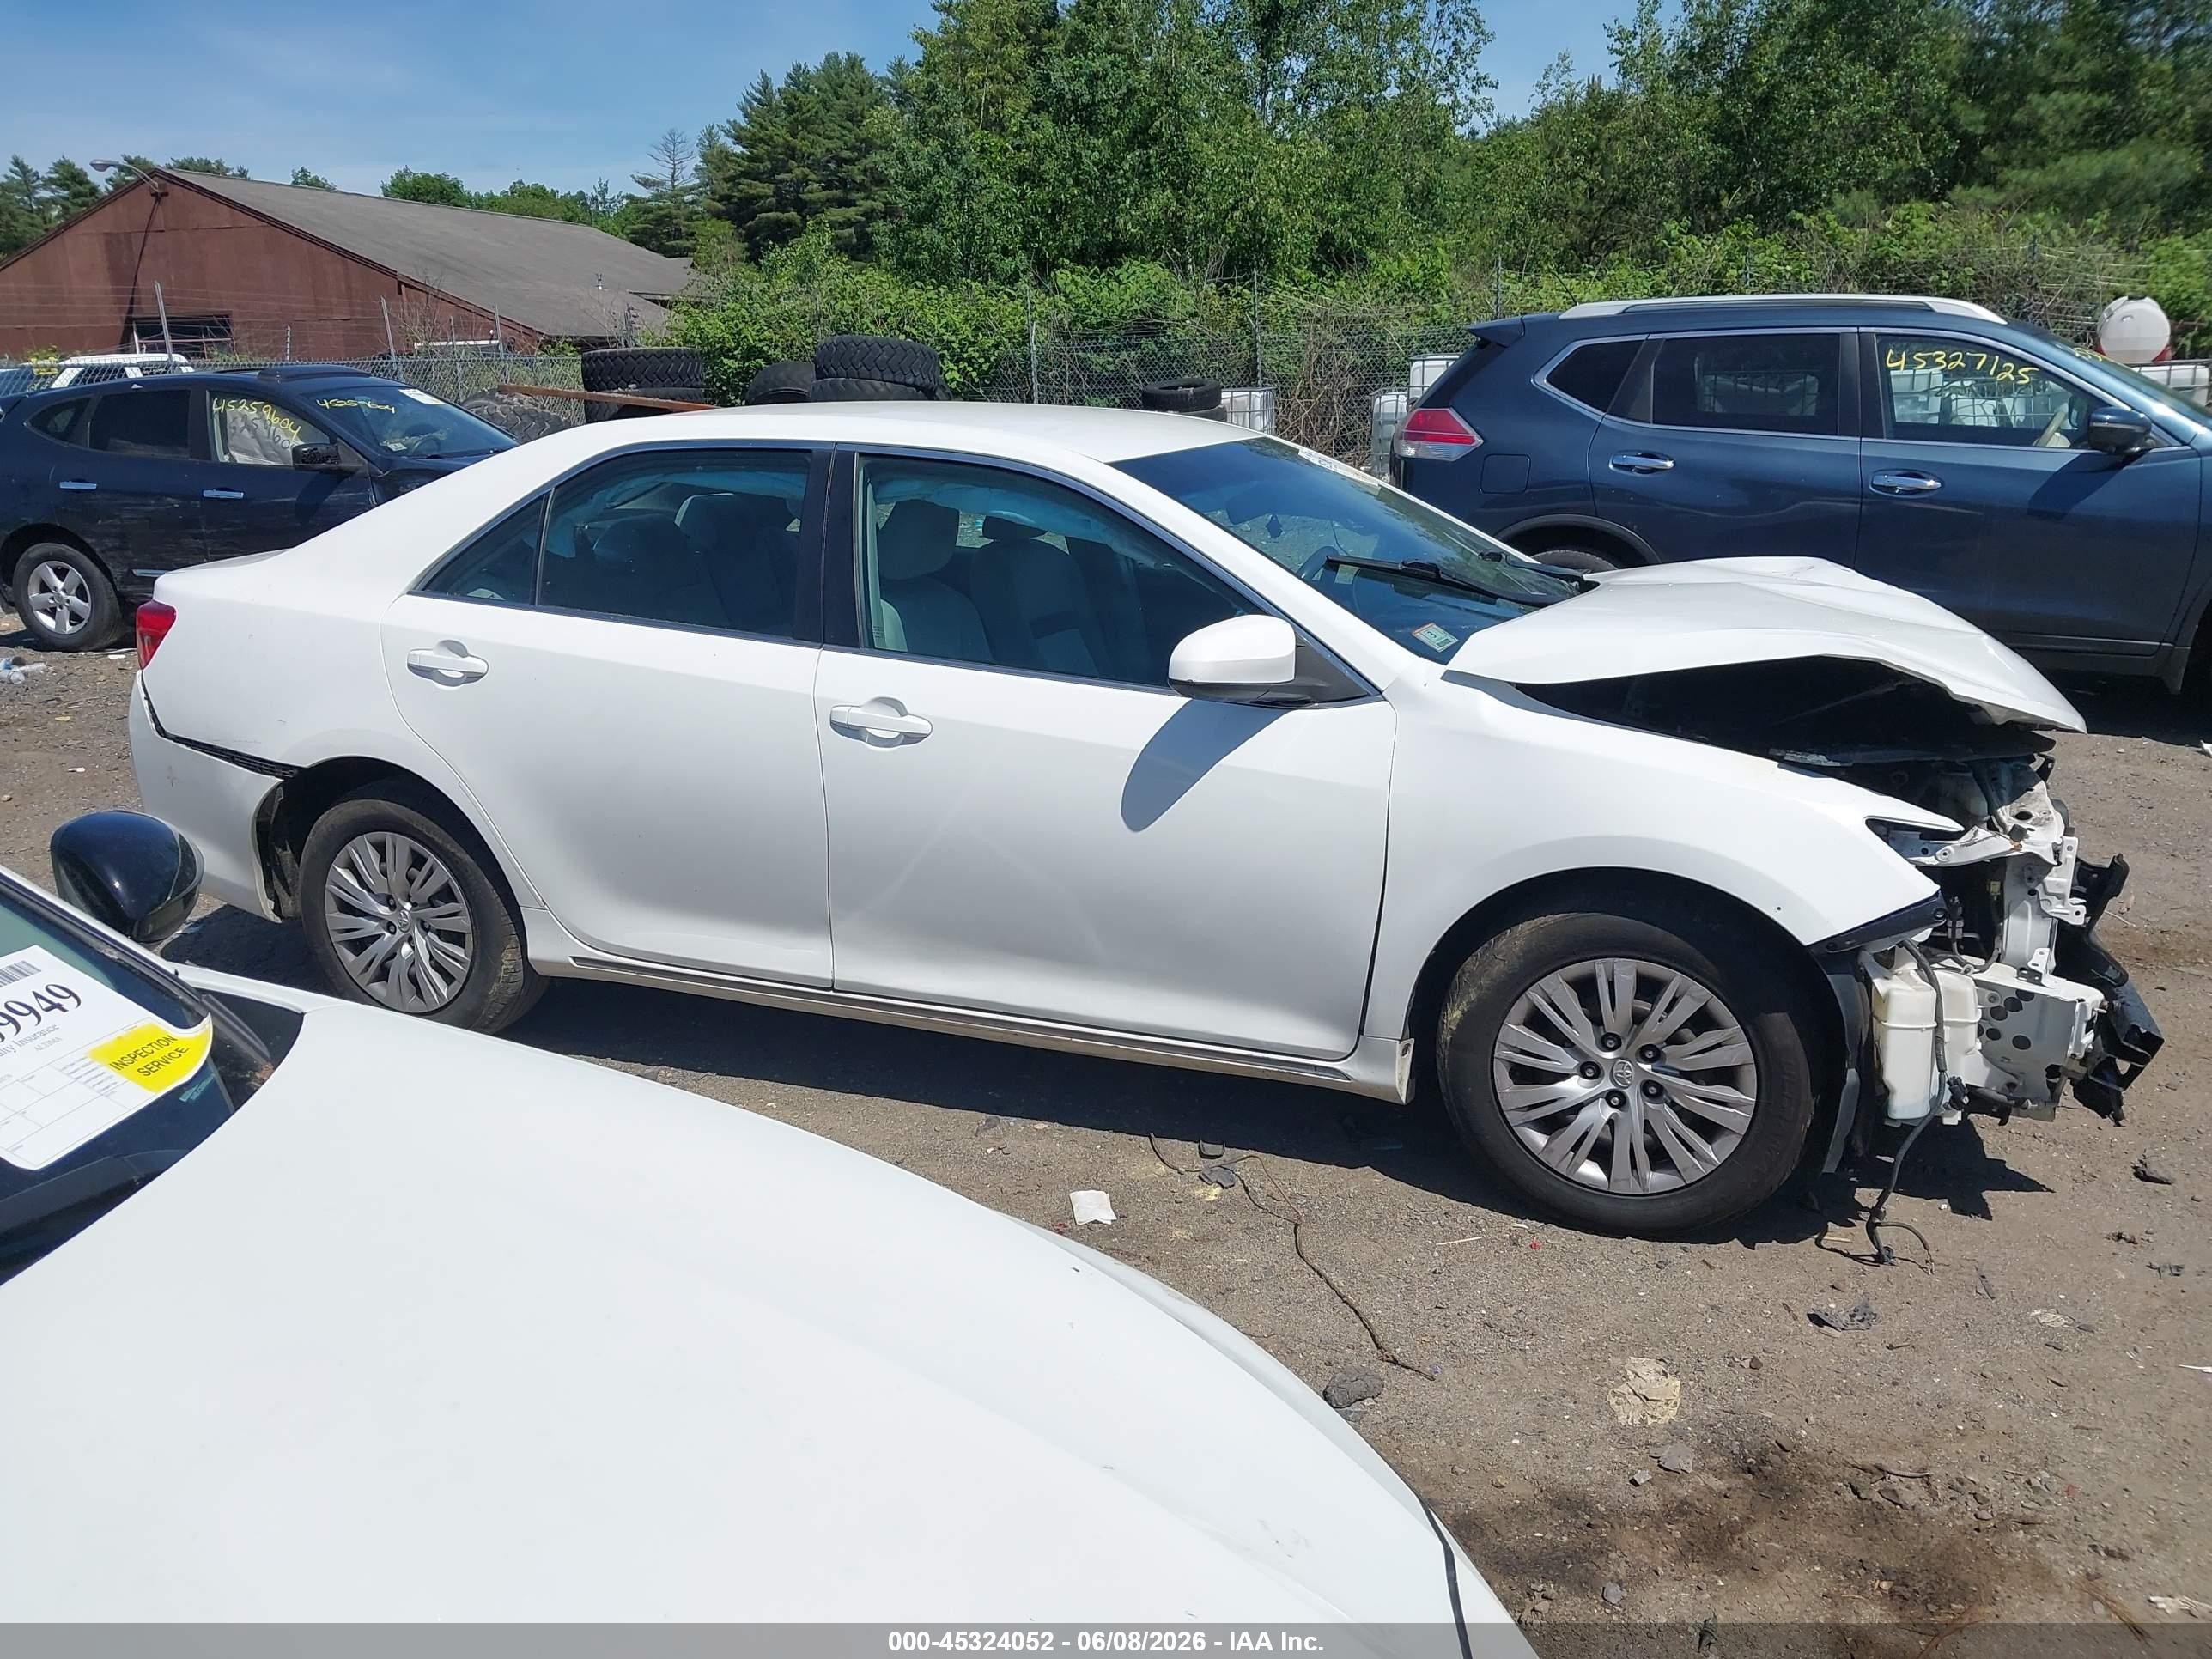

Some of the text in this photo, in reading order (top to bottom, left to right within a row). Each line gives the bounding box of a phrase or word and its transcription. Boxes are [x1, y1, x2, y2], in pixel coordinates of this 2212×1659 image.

[1886, 349, 2040, 385] 45327125
[212, 398, 301, 441] 45259604
[0, 983, 82, 1043] 9949
[109, 1034, 179, 1071] INSPECTION
[137, 1047, 191, 1077] SERVICE
